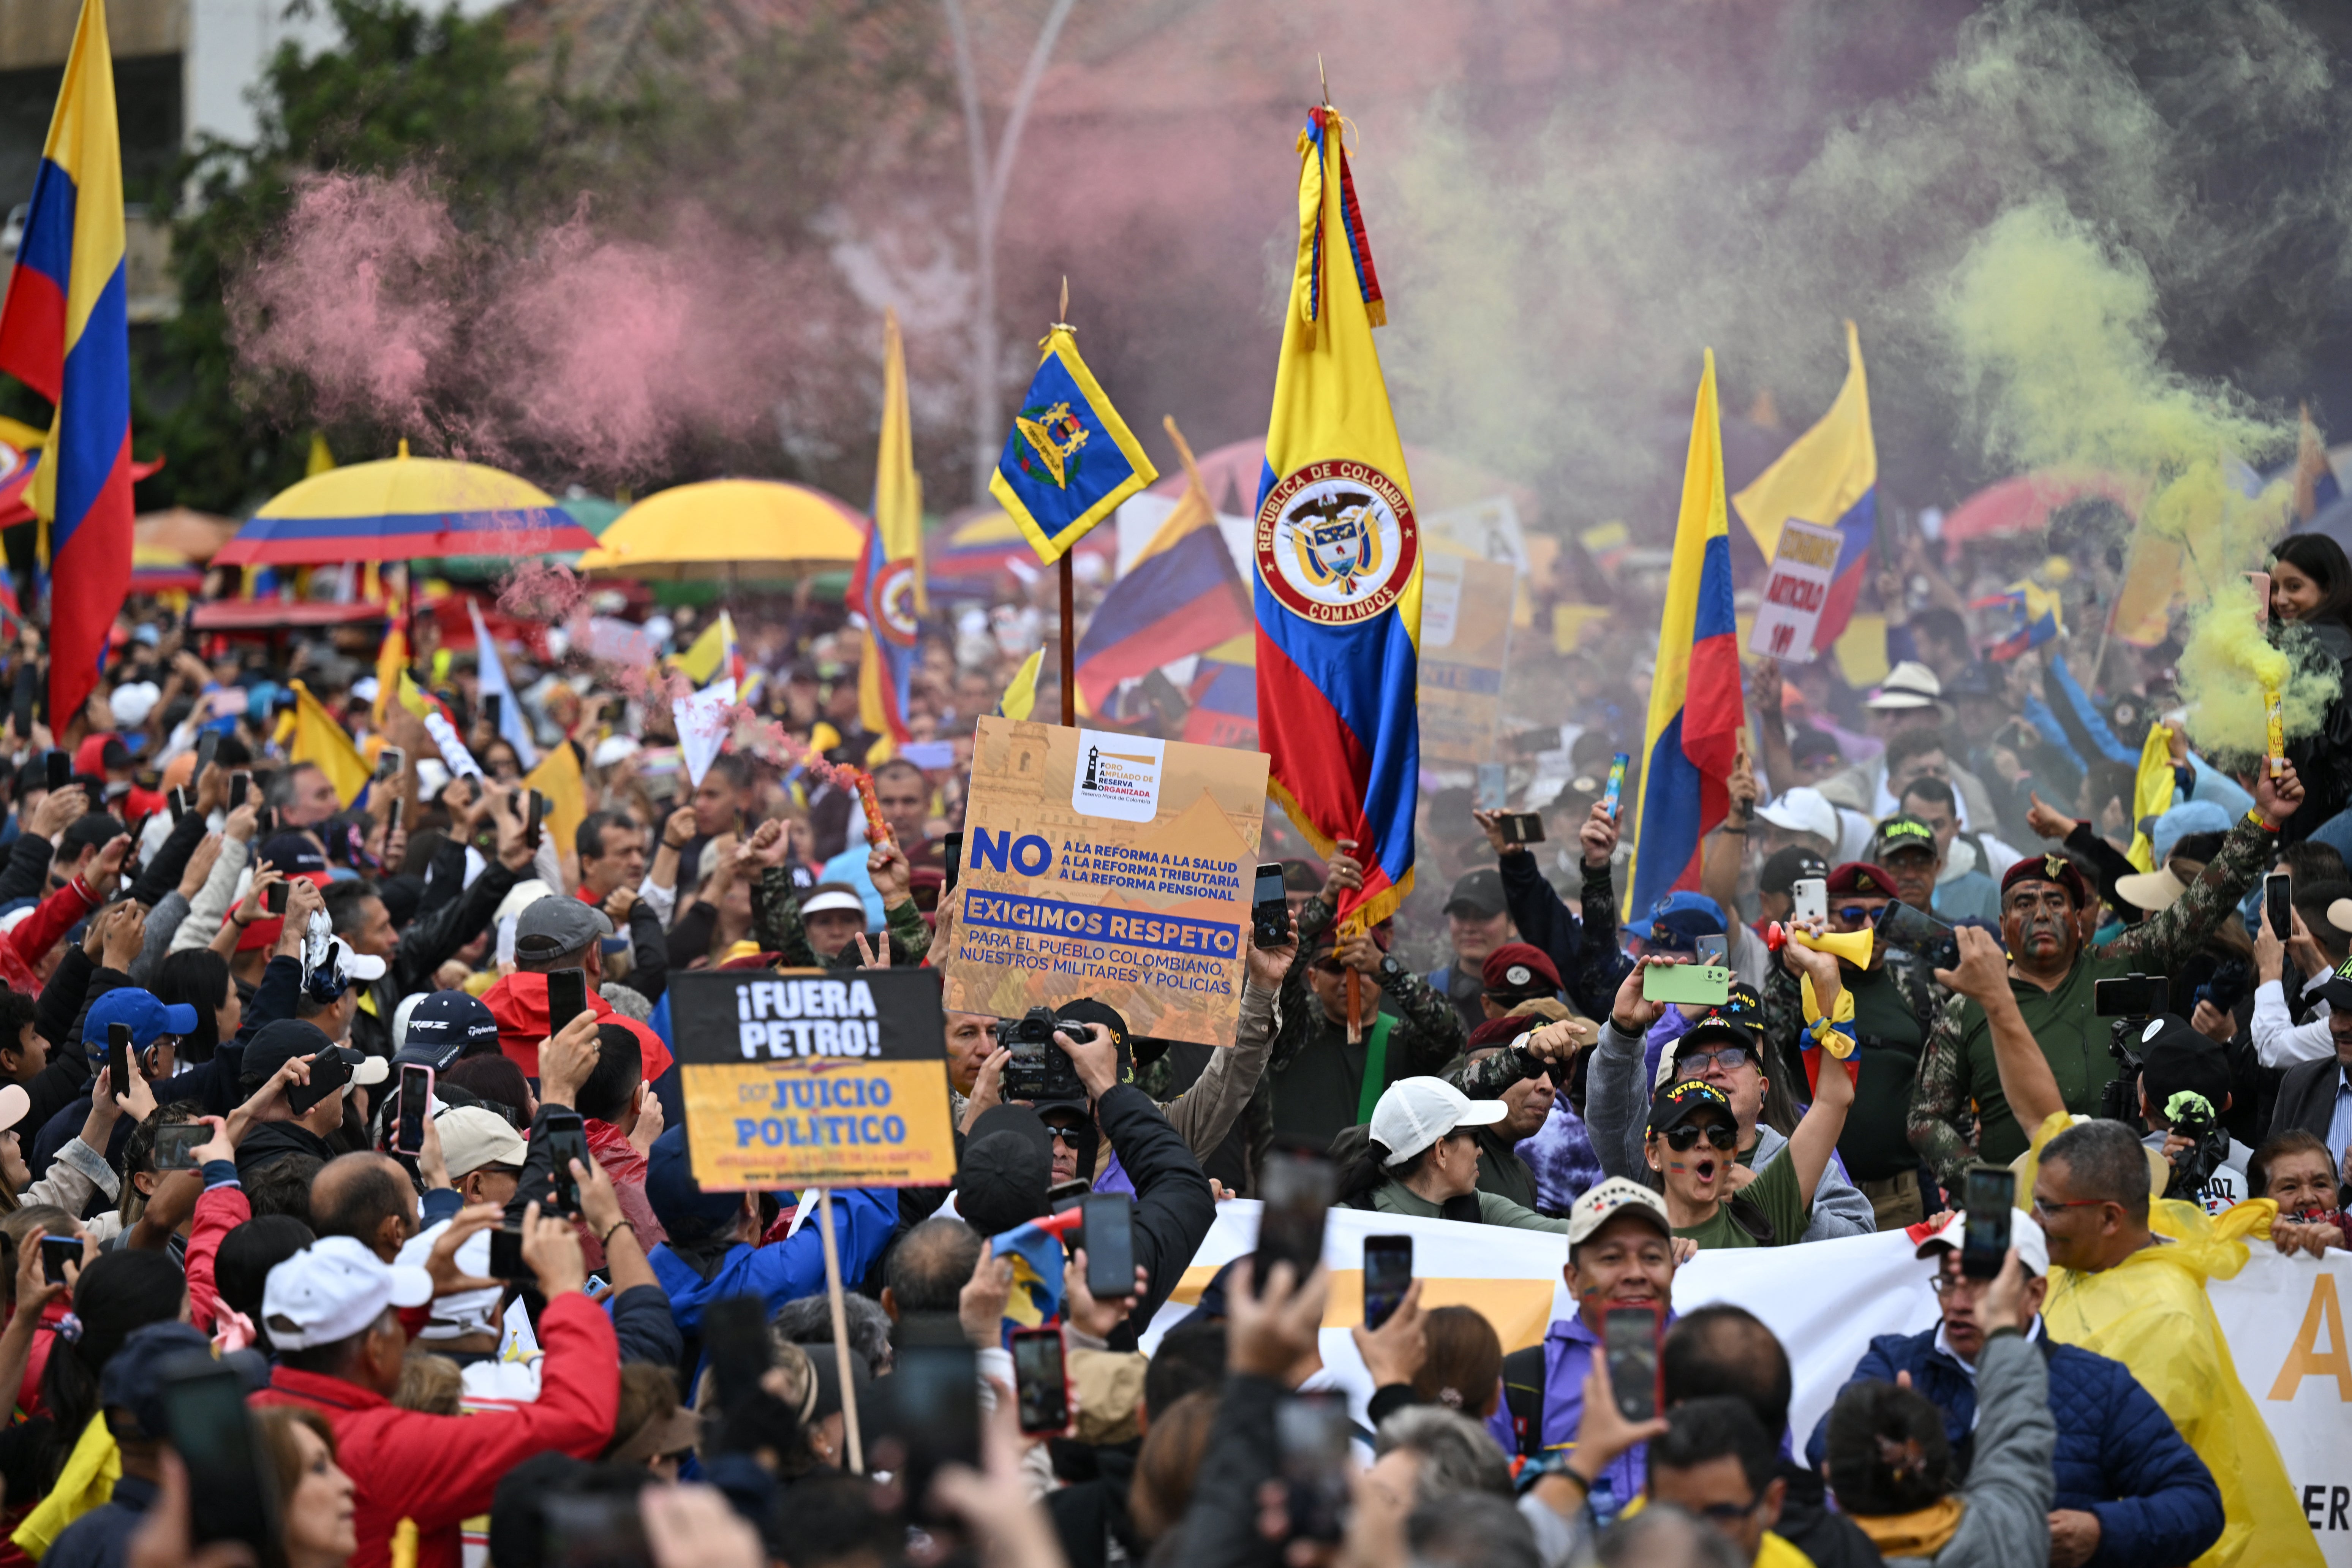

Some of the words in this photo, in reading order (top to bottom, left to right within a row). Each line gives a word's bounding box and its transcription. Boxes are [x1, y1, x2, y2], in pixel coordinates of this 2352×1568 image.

[1258, 474, 1306, 552] REPUBLICA
[1310, 464, 1331, 479] DE
[1340, 463, 1408, 519] COLOMBIA
[1309, 586, 1395, 621] COMANDOS
[1099, 770, 1141, 781] AMPLIADO
[1099, 778, 1133, 787] RESERVA
[1101, 762, 1122, 771] FORO
[1098, 785, 1150, 797] ORGANIZADA
[970, 827, 1052, 876] NO
[1063, 841, 1072, 852] A
[1075, 842, 1091, 854] LA
[1095, 845, 1159, 863] REFORMA
[1161, 854, 1170, 865] A
[1173, 855, 1190, 867] LA
[1193, 858, 1237, 873] SALUD
[1059, 869, 1069, 880] A
[1072, 871, 1088, 882] LA
[1091, 873, 1155, 891] REFORMA
[1159, 882, 1235, 901] PENSIONAL
[1061, 855, 1070, 866] A
[1073, 856, 1090, 868] LA
[1092, 859, 1157, 877] REFORMA
[1160, 867, 1240, 888] TRIBUTARIA
[967, 896, 1103, 934] EXIGIMOS
[1109, 915, 1235, 952] RESPETO
[969, 930, 1011, 948] PARA
[1016, 936, 1035, 952] EL
[1039, 940, 1105, 960] PUEBLO
[1109, 950, 1224, 978] COLOMBIANO,
[959, 946, 1048, 971] NUESTROS
[1053, 959, 1138, 982] MILITARES
[1142, 971, 1153, 984] Y
[1156, 973, 1231, 995] POLICIAS
[735, 979, 877, 1021] ¡FUERA
[1736, 991, 1756, 1007] ANO
[738, 1019, 882, 1059] PETRO!
[1109, 1028, 1121, 1045] NO
[771, 1078, 891, 1110] JUICIO
[1667, 1081, 1726, 1103] VETERANO
[2303, 1485, 2350, 1531] ER
